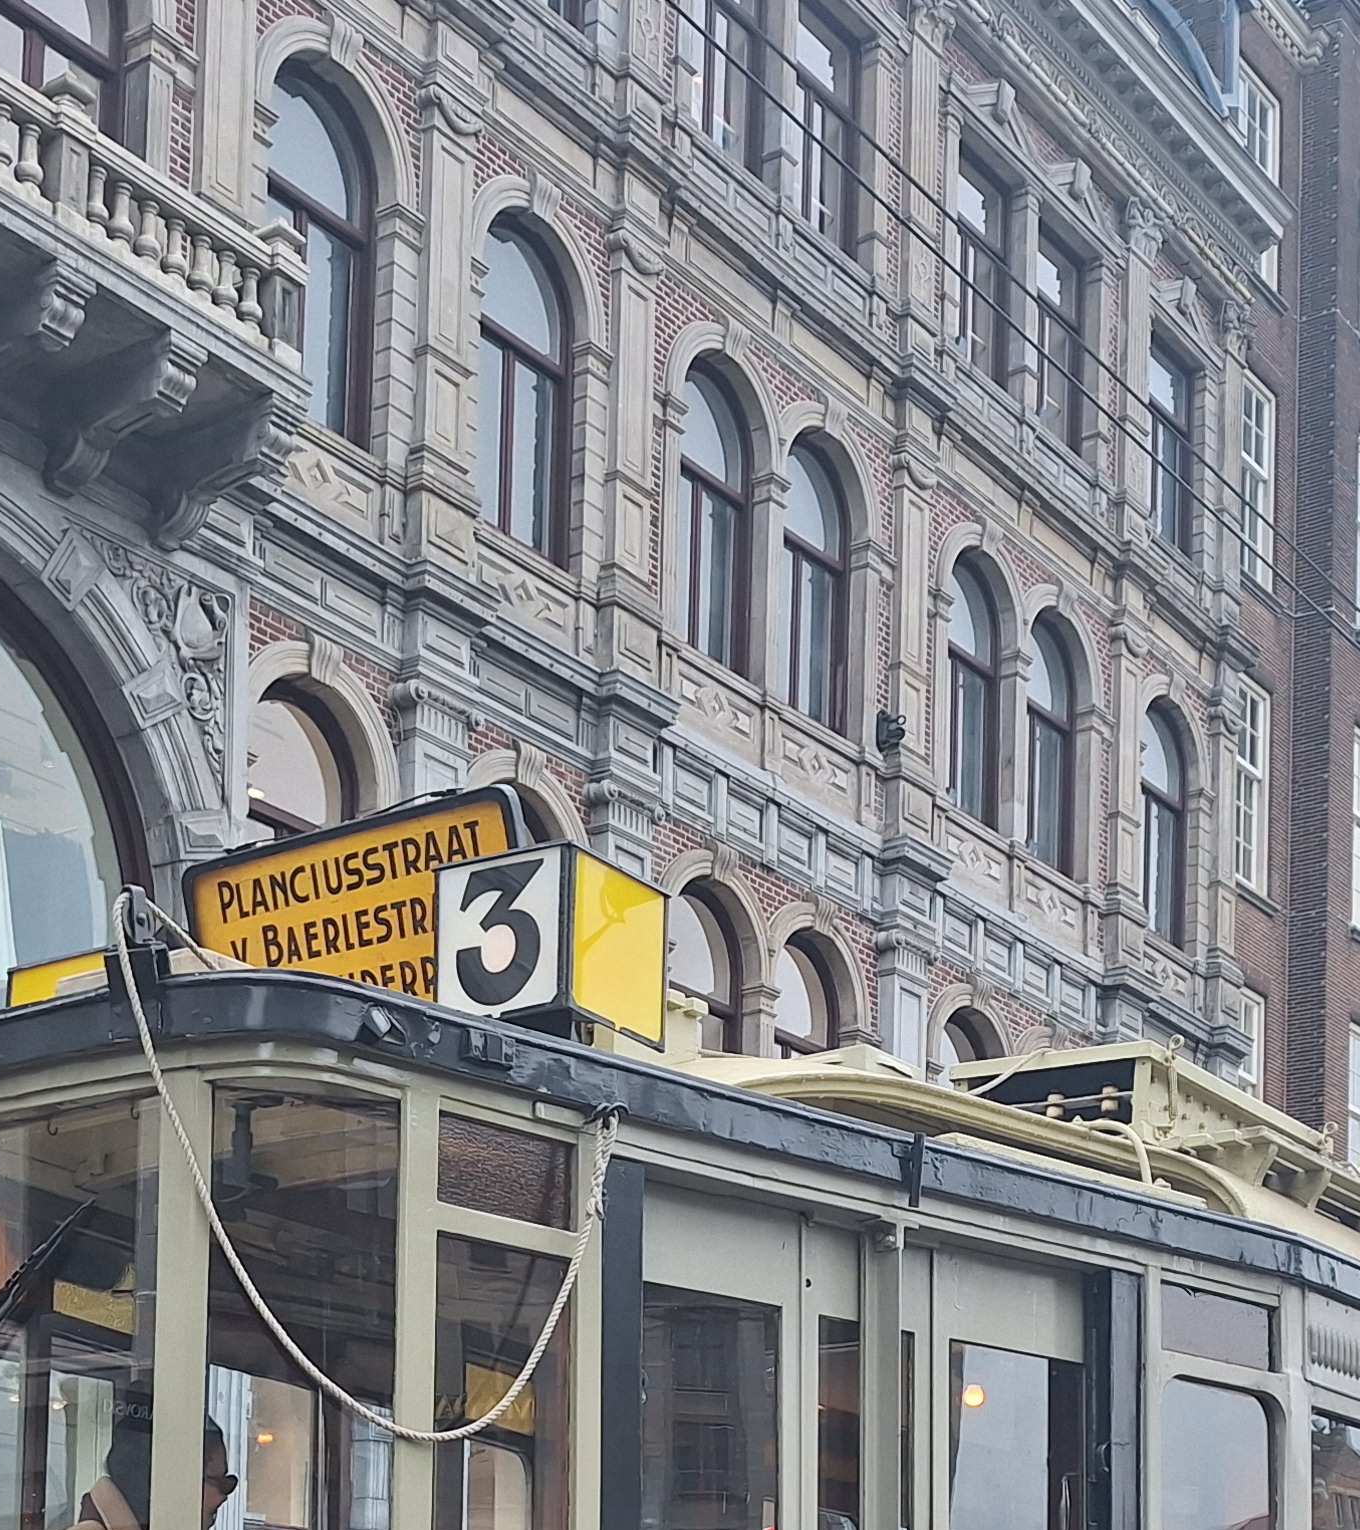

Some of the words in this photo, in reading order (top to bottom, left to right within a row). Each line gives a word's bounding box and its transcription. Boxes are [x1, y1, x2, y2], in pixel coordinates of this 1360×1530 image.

[217, 819, 480, 924] PLANCIUSSTRAAT
[261, 893, 435, 968] BAERLESTR
[456, 857, 545, 1006] 3
